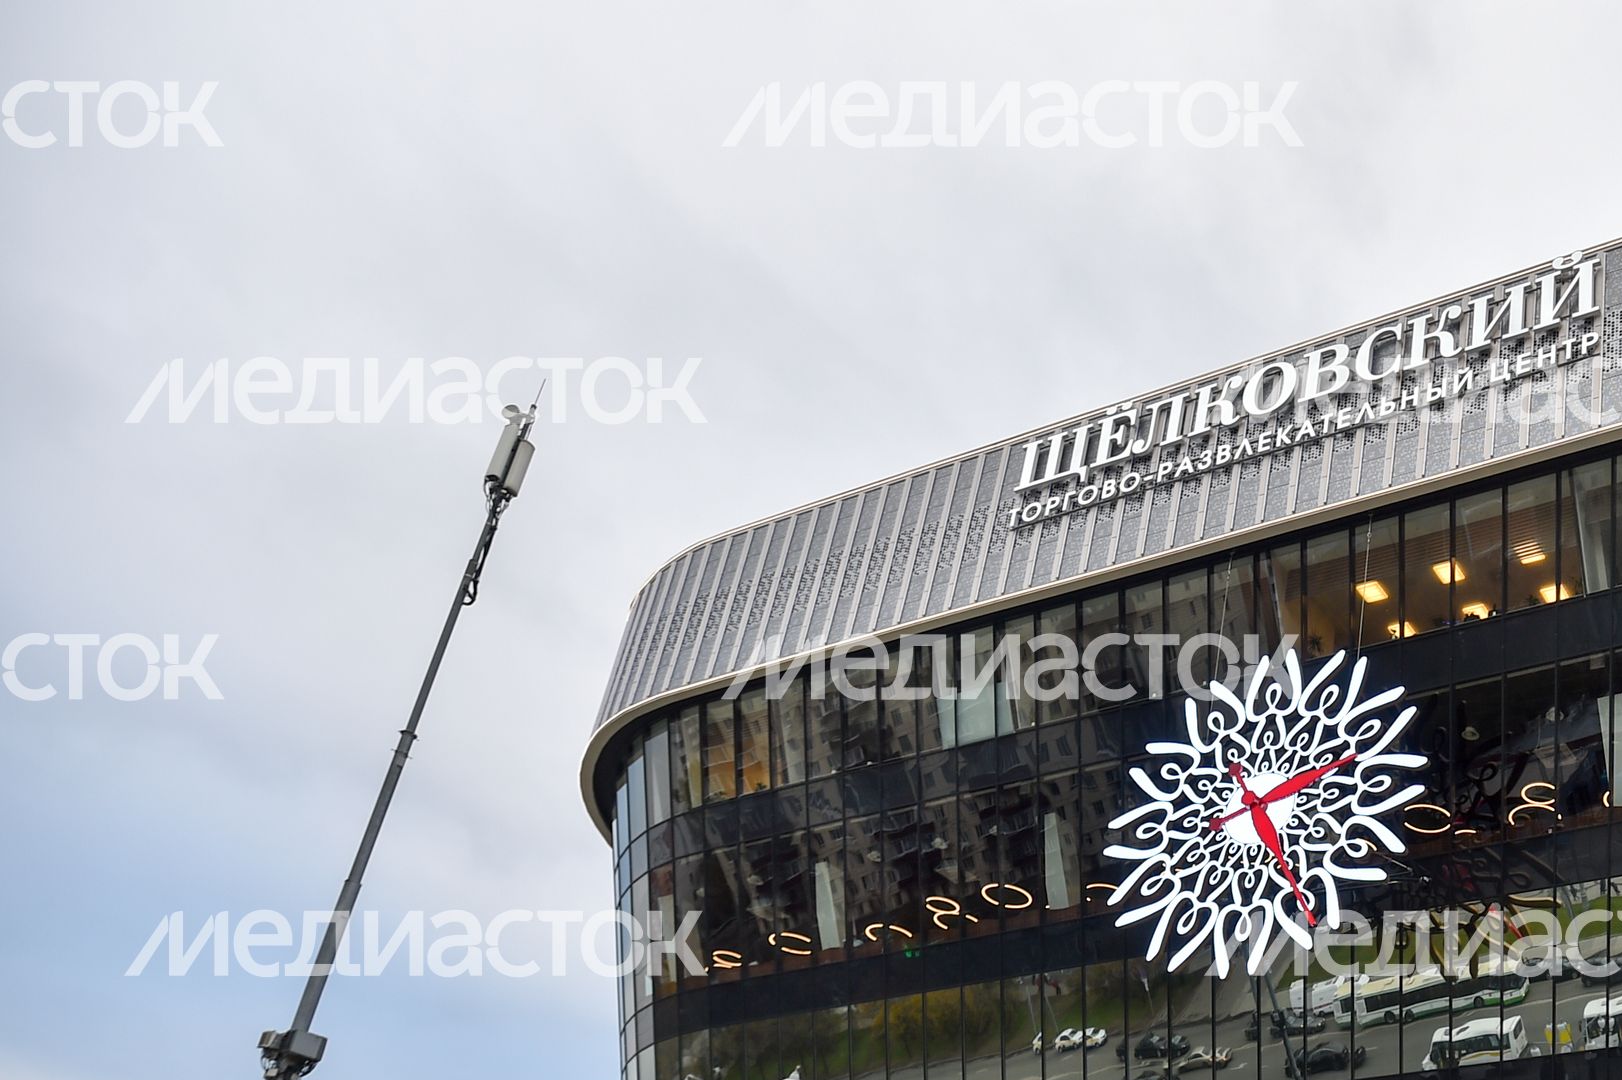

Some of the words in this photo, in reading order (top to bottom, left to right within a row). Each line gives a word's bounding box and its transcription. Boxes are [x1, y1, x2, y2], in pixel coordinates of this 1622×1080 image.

[1008, 367, 1475, 529] ТОРГОВО-РАЗВЛЕКАТЕЛЬНЫЙ
[1490, 331, 1600, 382] ЦЕНТР
[1013, 251, 1602, 494] ЩЁЛКОВСКИЙ
